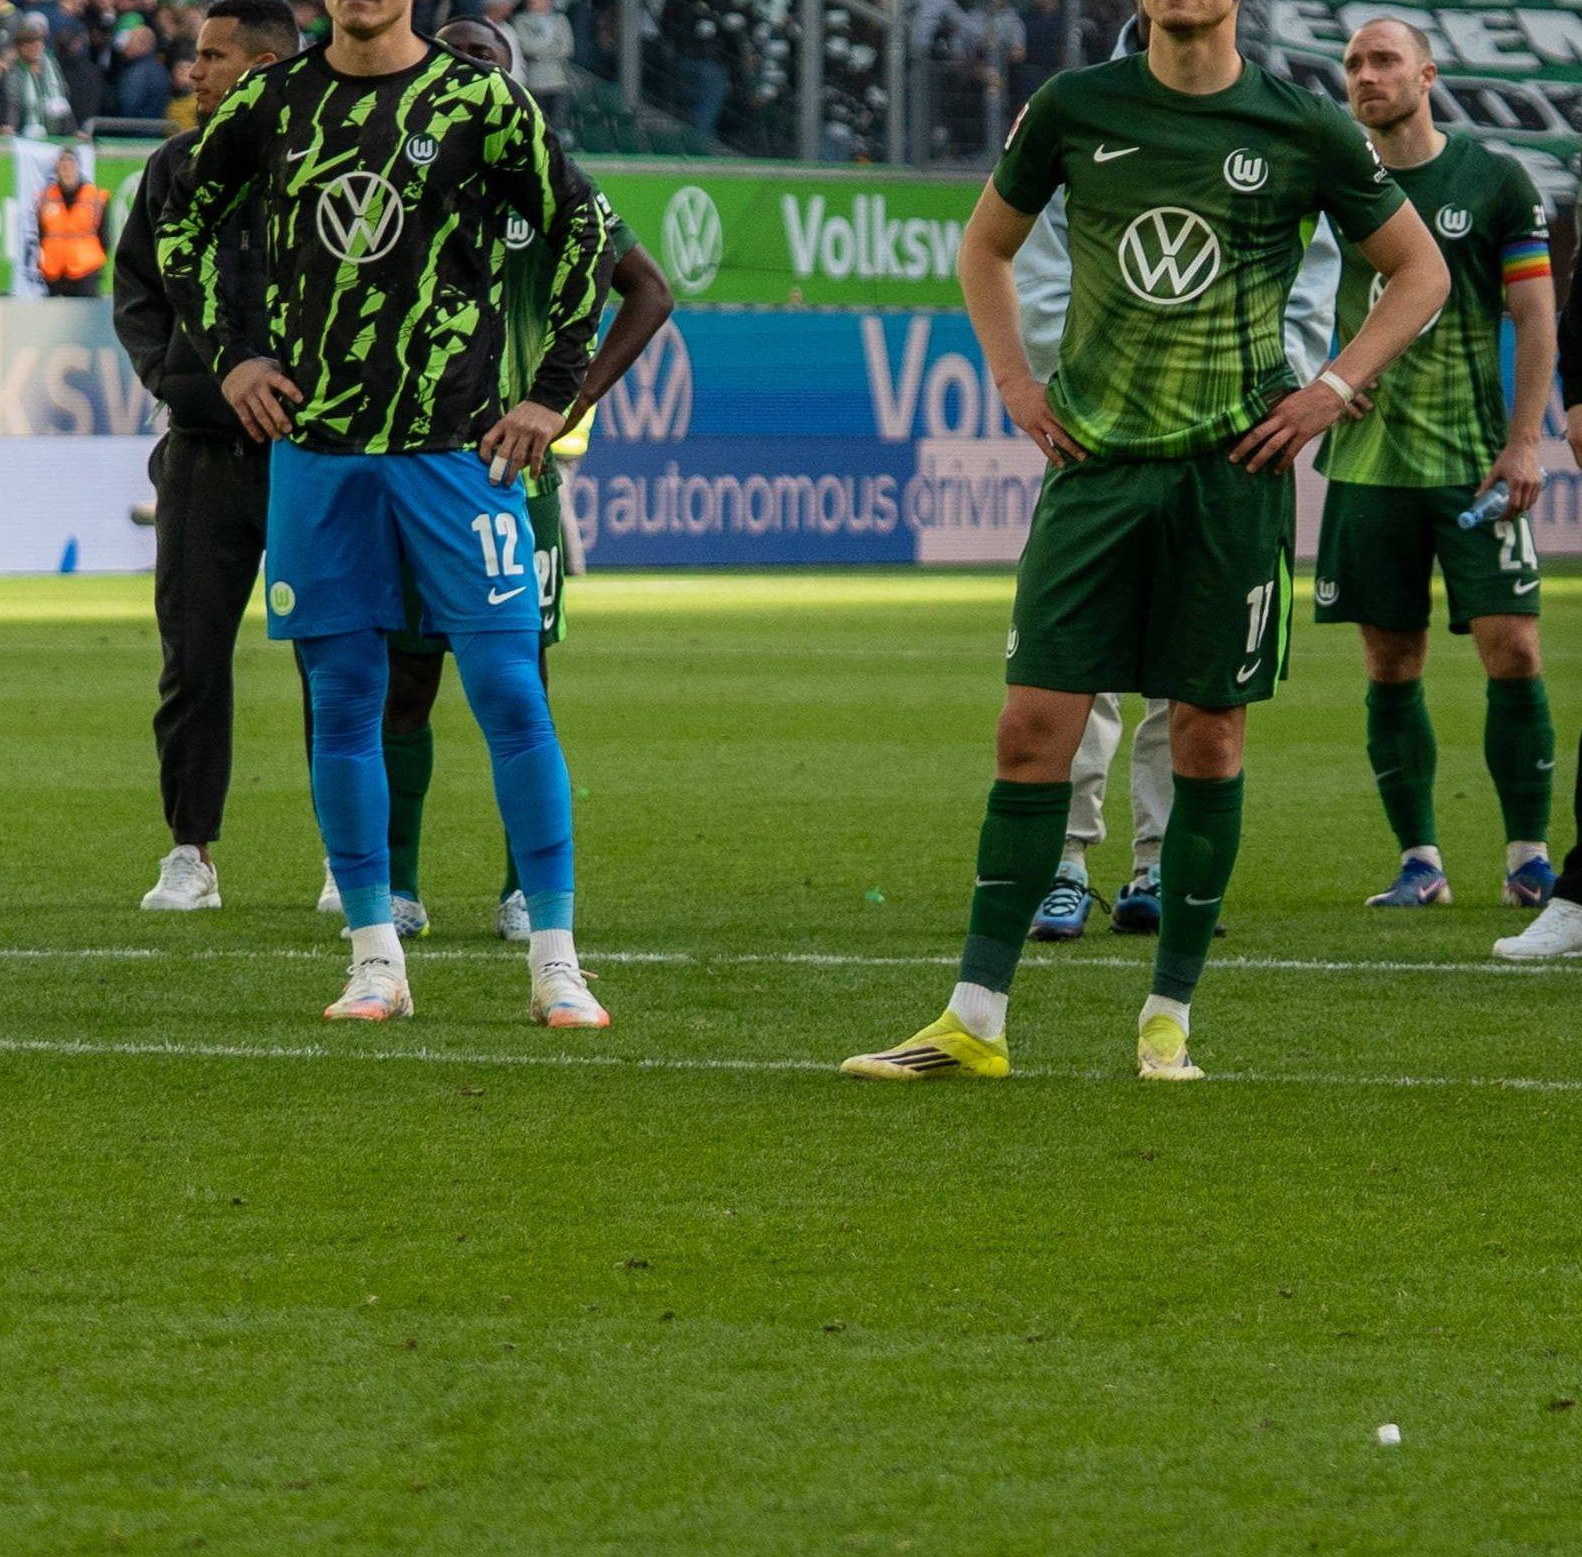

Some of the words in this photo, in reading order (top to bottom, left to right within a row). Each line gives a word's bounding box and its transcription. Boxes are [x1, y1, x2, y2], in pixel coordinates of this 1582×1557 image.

[605, 461, 899, 536] autonomous
[471, 512, 524, 577] 12
[1494, 516, 1539, 571] 24
